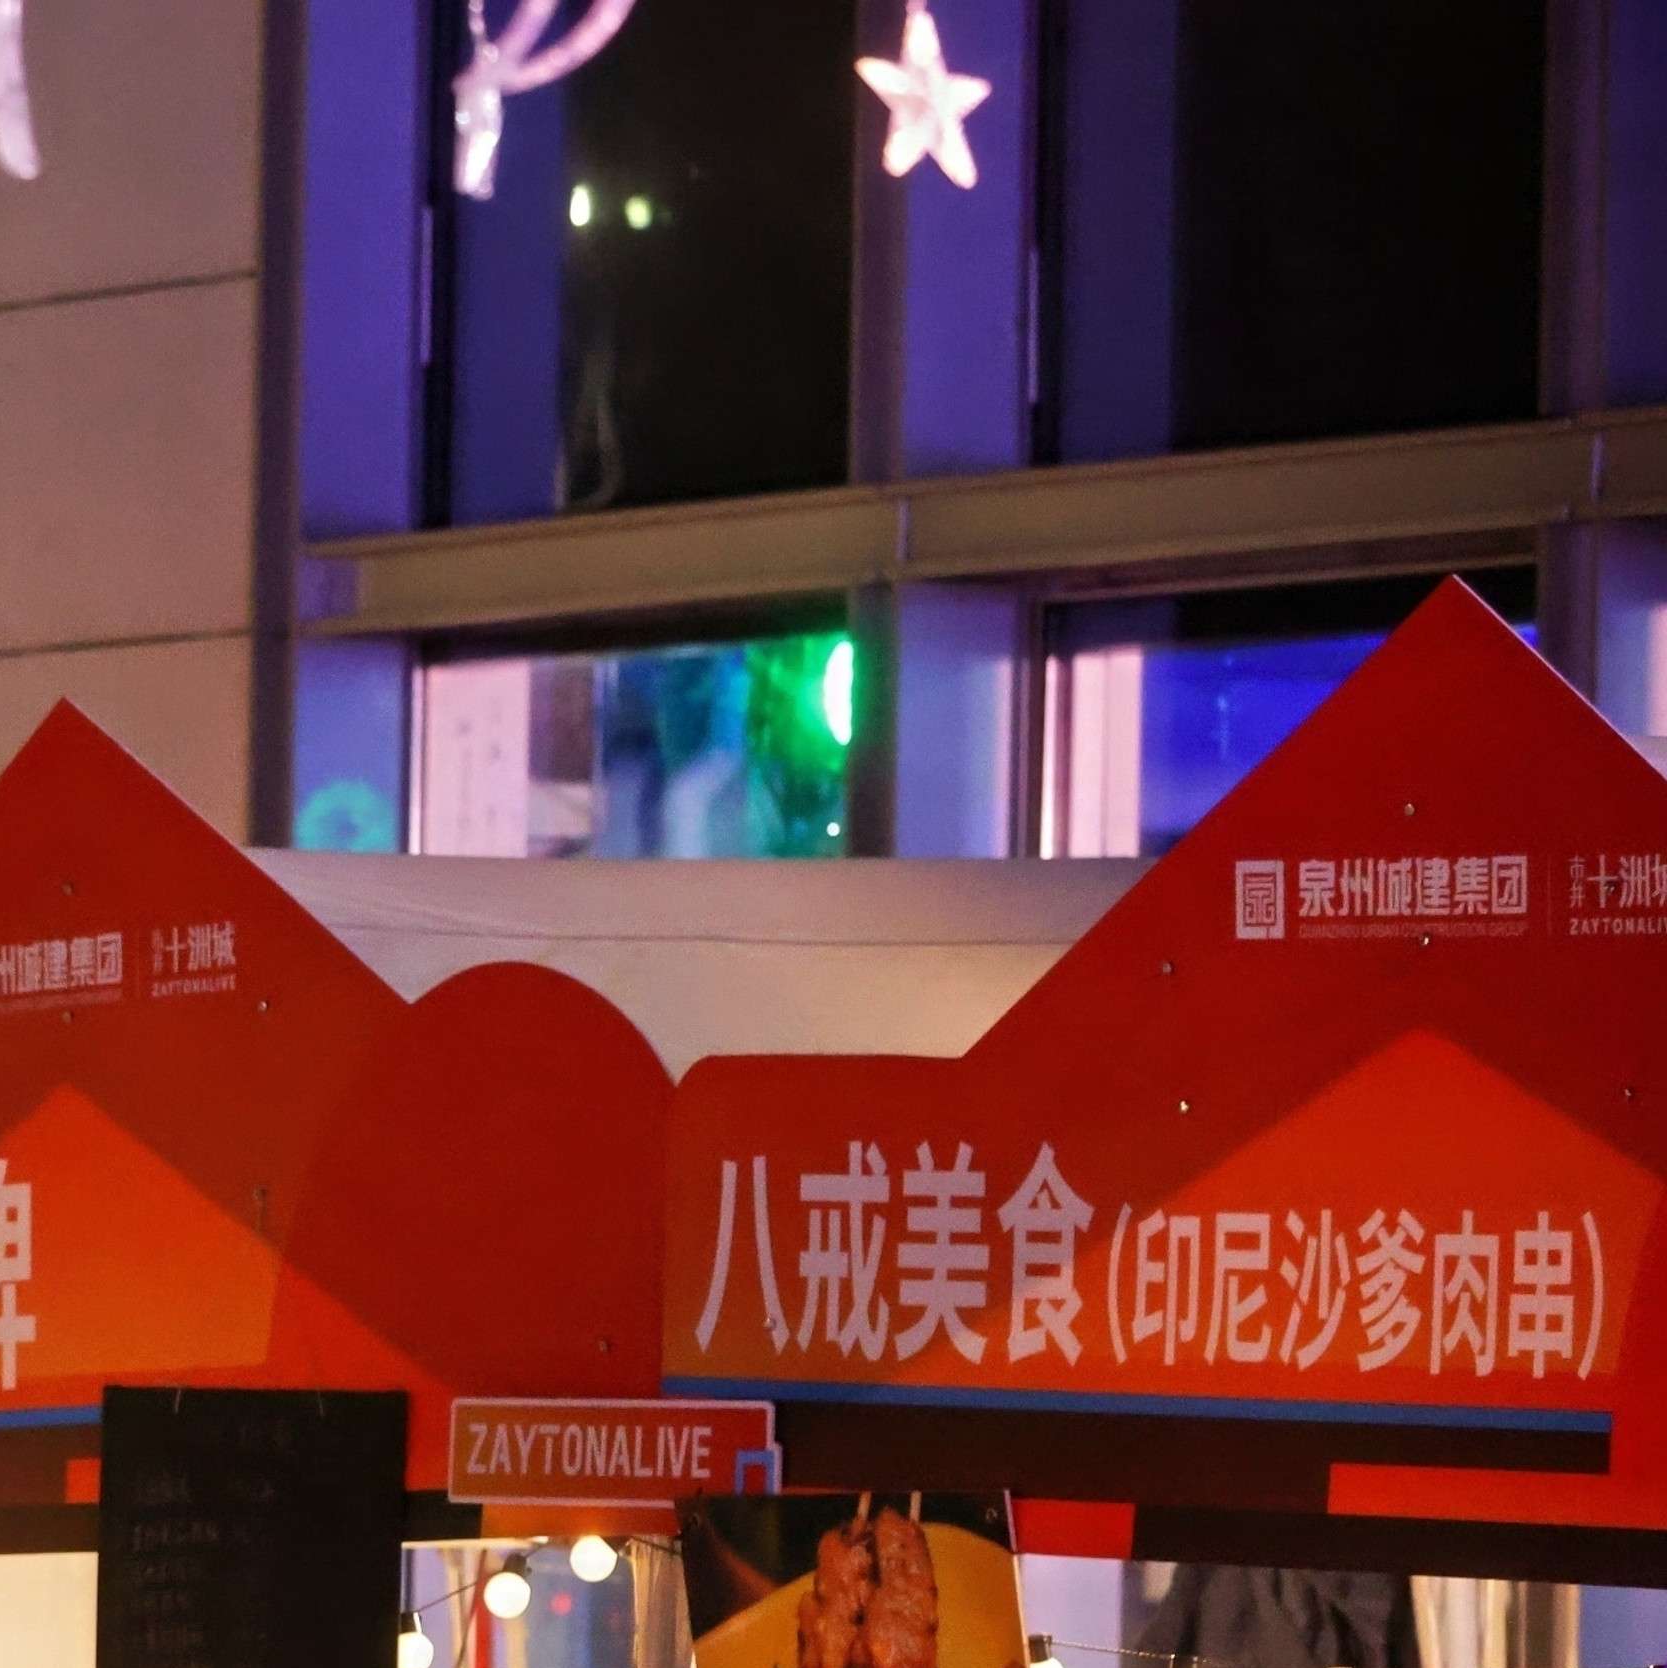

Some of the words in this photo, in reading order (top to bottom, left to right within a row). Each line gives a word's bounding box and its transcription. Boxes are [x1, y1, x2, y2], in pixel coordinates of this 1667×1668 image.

[1298, 856, 1528, 917] 泉州城建集团
[694, 1139, 1603, 1382] 八戒美食(印尼沙爹肉串)
[466, 1421, 712, 1481] ZAYTONALIVE
